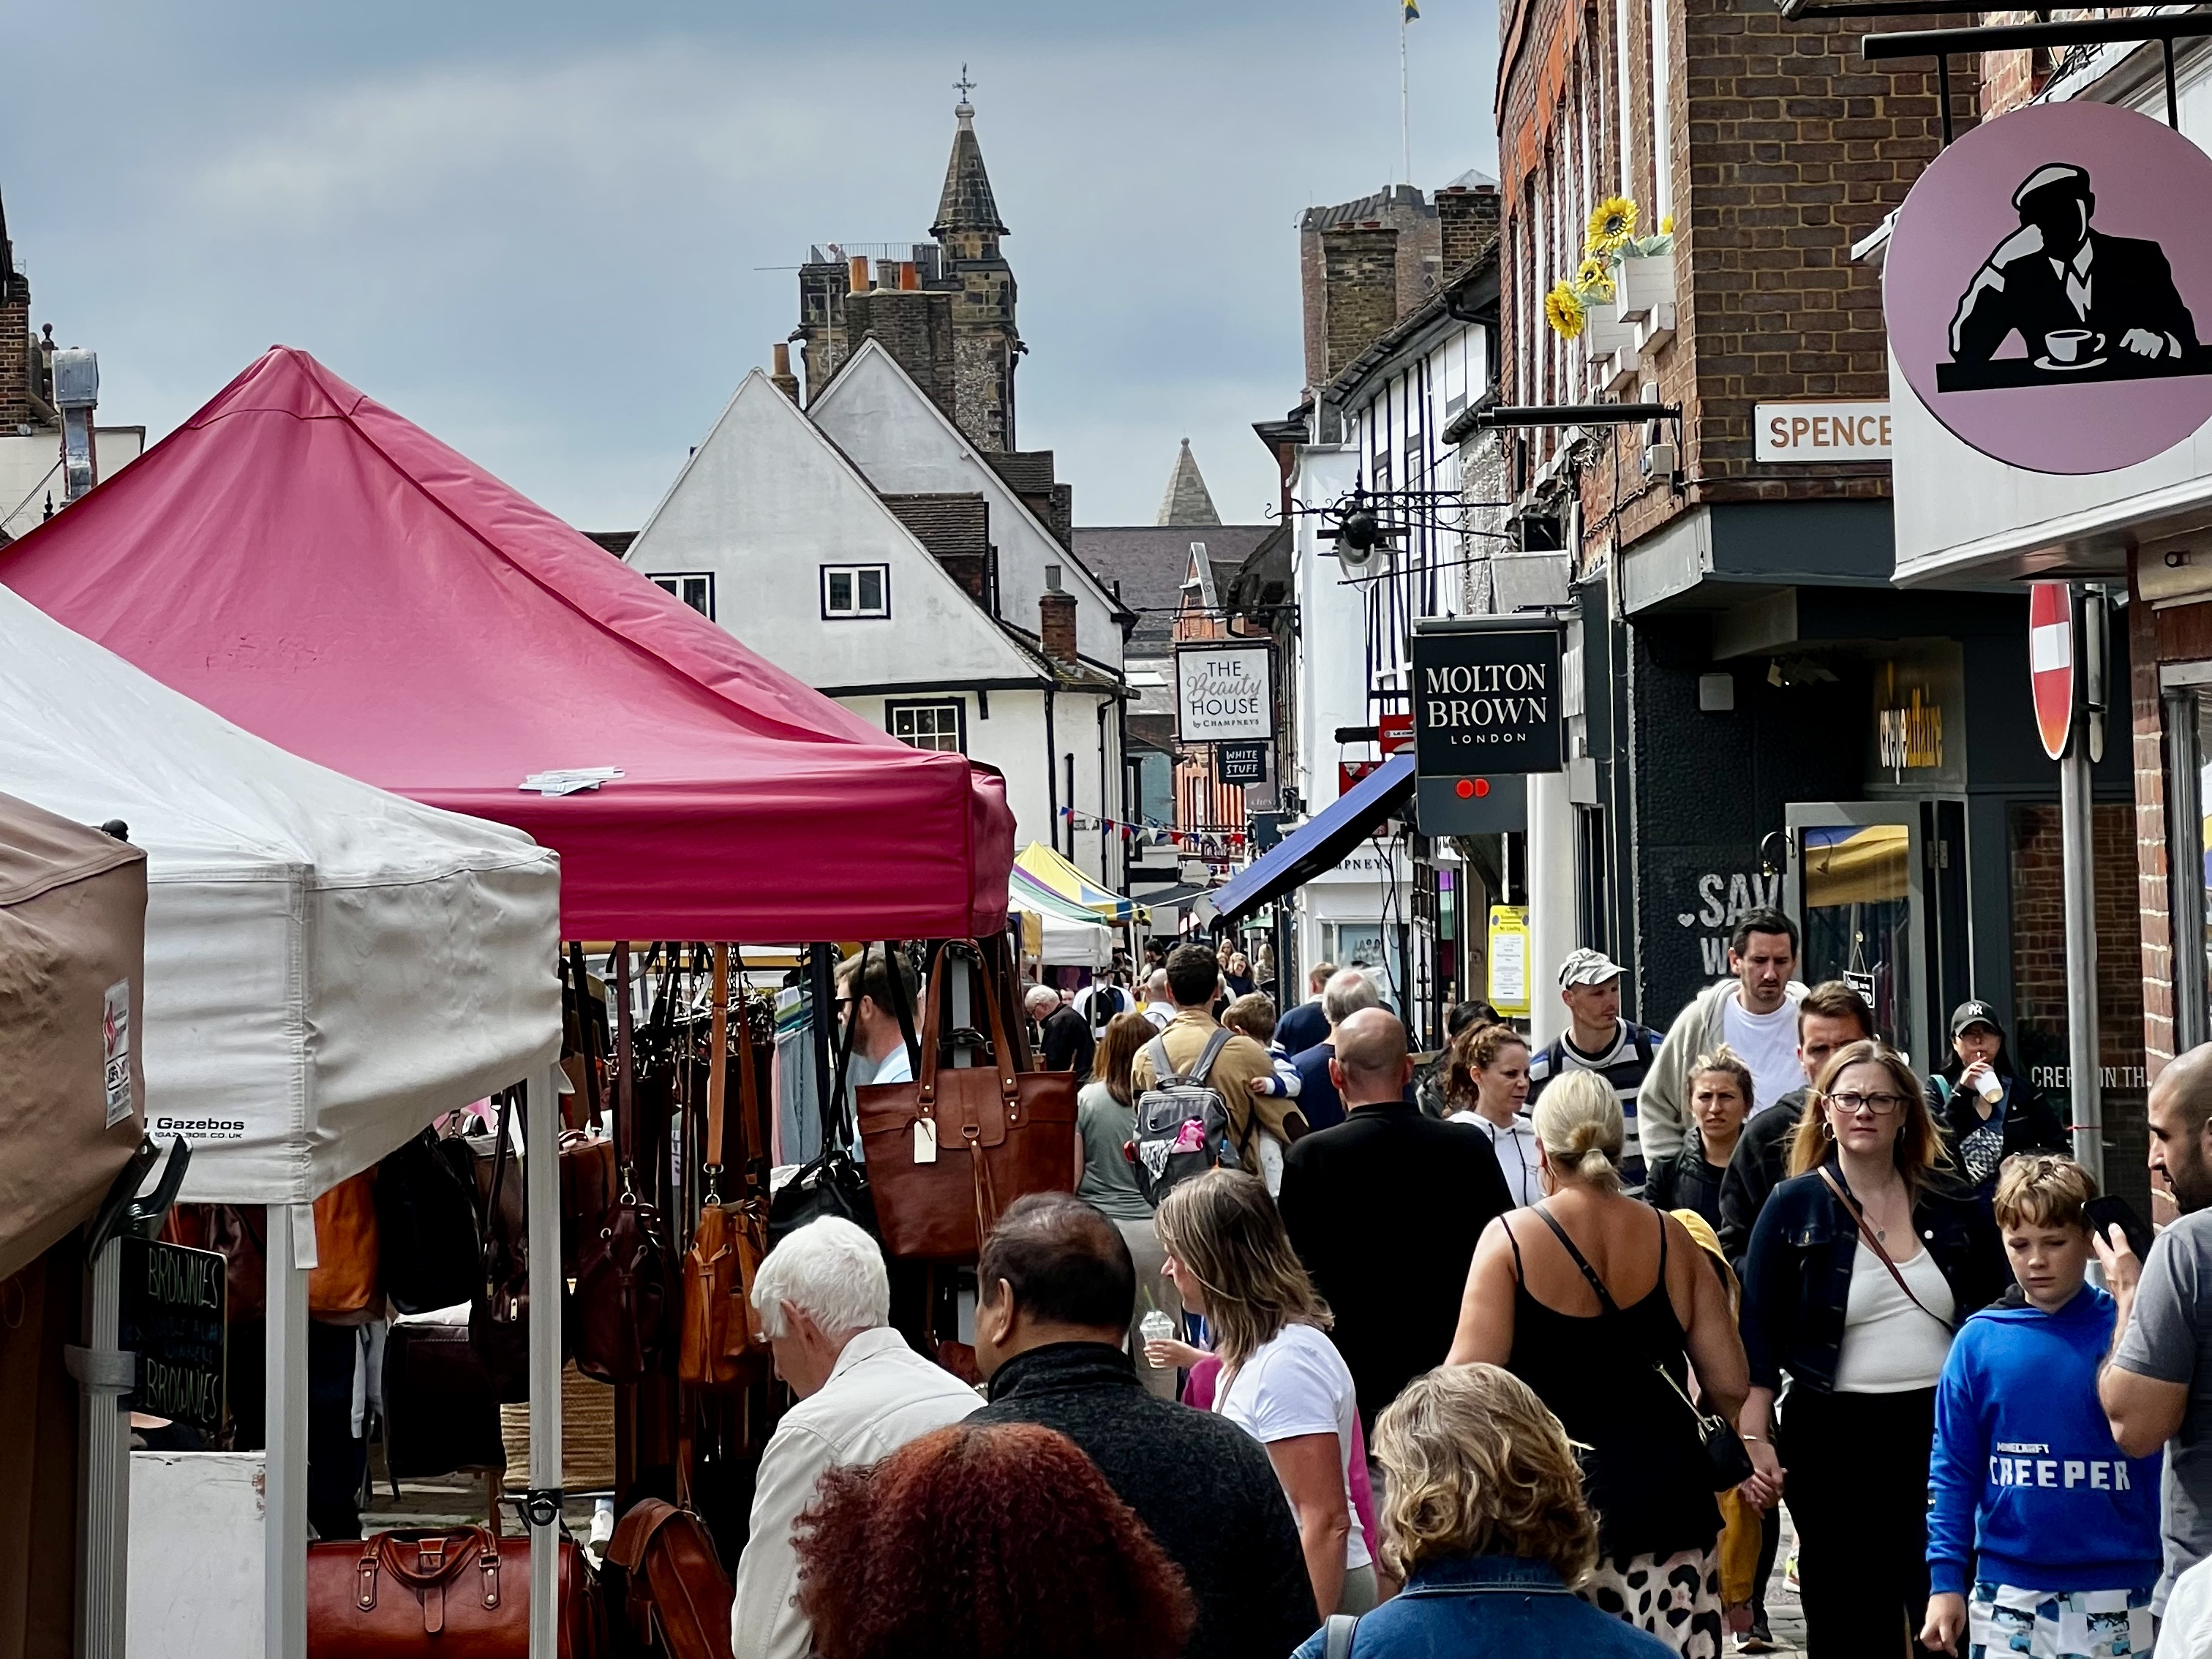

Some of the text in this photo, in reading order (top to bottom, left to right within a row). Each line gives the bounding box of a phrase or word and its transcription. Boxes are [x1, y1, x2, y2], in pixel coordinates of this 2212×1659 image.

[1206, 661, 1241, 677] THE
[1426, 663, 1546, 694] MOLTON
[1186, 672, 1262, 704] Beauty
[1192, 698, 1259, 715] HOUSE
[1426, 696, 1547, 728] BROWN
[1192, 720, 1201, 729] by
[1451, 733, 1526, 745] LONDON
[1226, 750, 1257, 760] WHITE
[1227, 764, 1258, 774] STUFF
[157, 1117, 244, 1130] Gazebos
[1989, 1455, 2131, 1491] CREEPER
